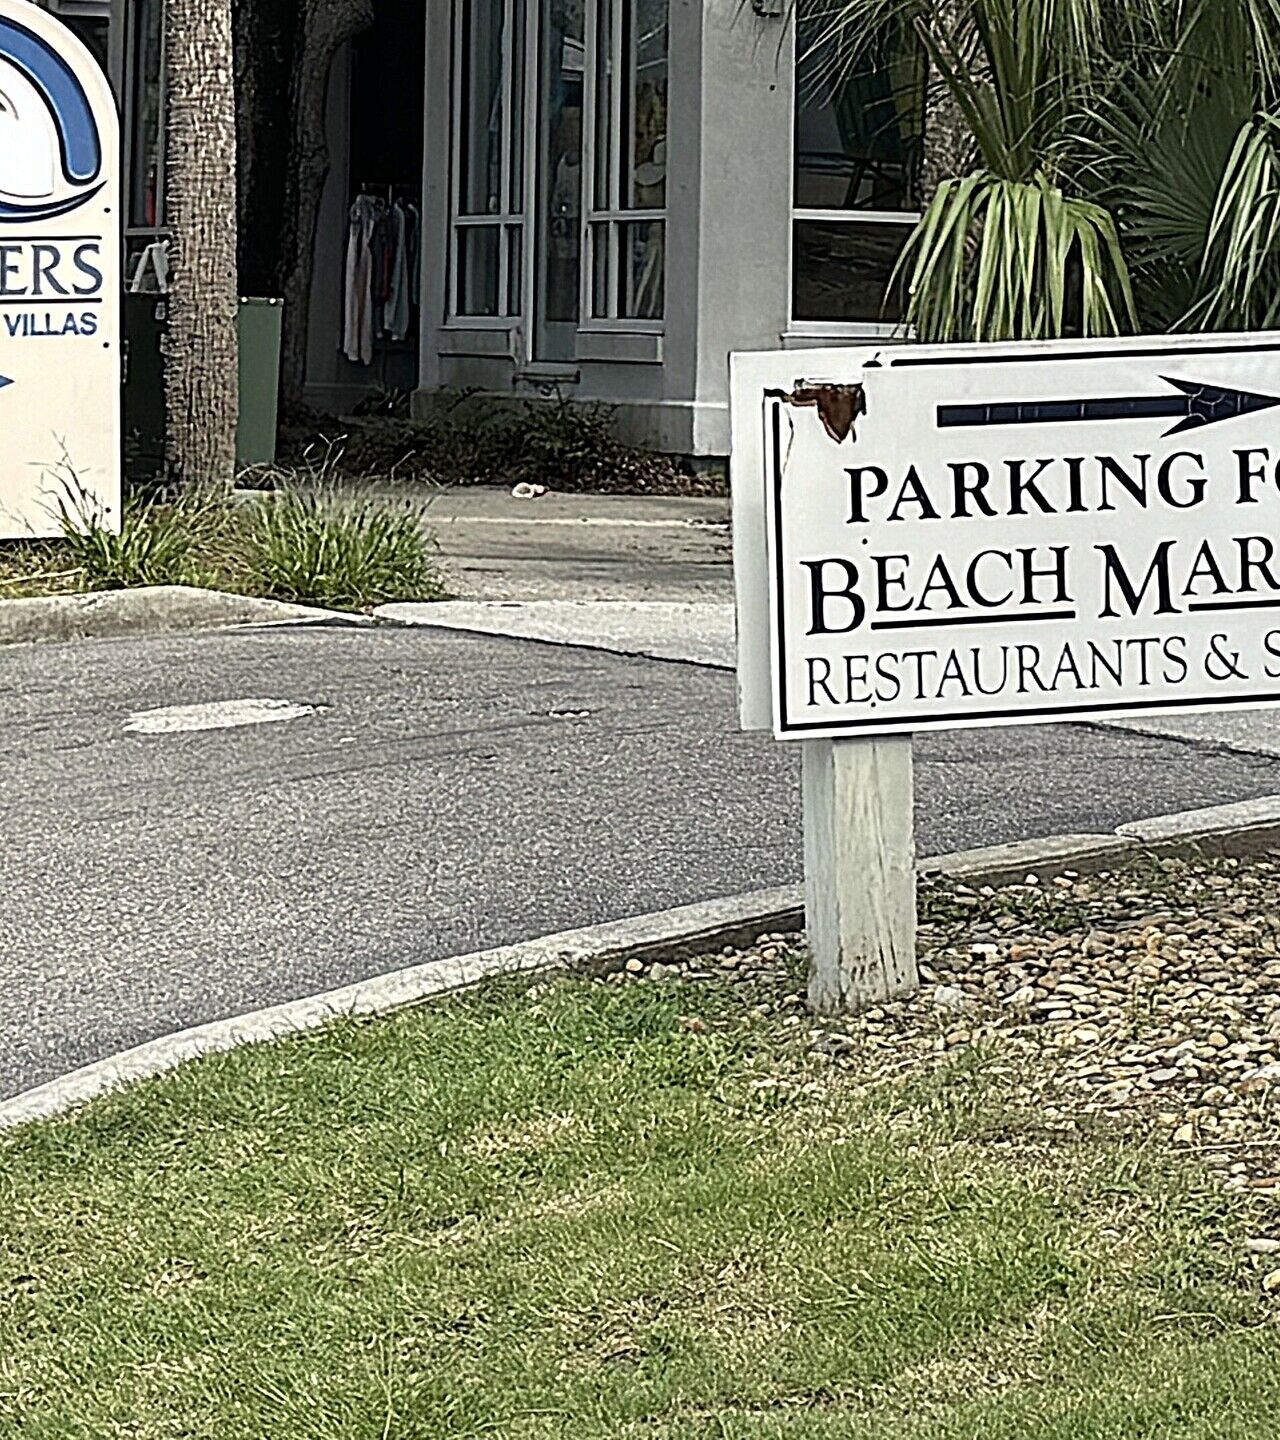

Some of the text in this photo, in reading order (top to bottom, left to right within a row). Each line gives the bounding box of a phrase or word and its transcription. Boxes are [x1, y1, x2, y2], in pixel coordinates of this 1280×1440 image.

[4, 312, 99, 336] VILLAS
[844, 450, 1208, 524] PARKING
[800, 544, 1074, 636] BEACH
[807, 636, 1188, 707] RESTAURANTS
[1204, 633, 1249, 681] &
